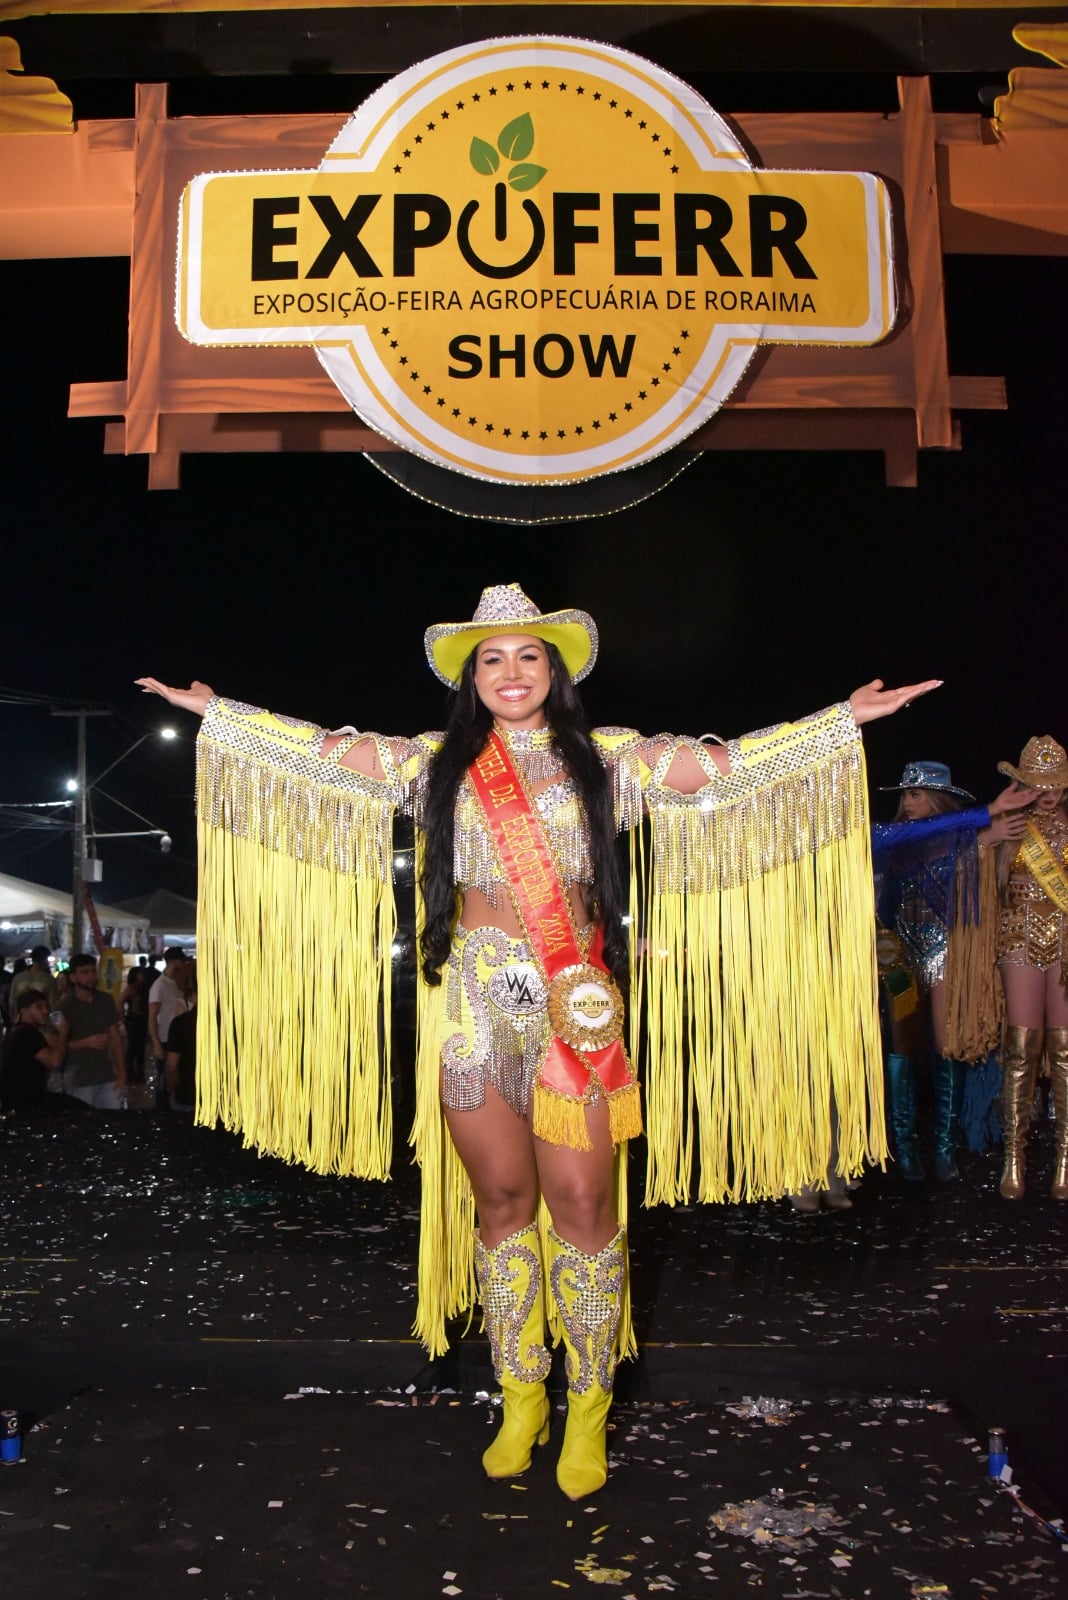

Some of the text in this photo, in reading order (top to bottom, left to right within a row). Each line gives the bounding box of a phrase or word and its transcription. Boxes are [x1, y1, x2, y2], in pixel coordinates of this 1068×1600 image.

[251, 184, 818, 283] EXPOFERR
[253, 284, 817, 318] EXPOSIÇÃO-FEIRA AGROPECUÁRIA DE RORAIMA
[448, 334, 636, 379] SHOW
[475, 739, 570, 955] NHA DA EXPOFERR 2024
